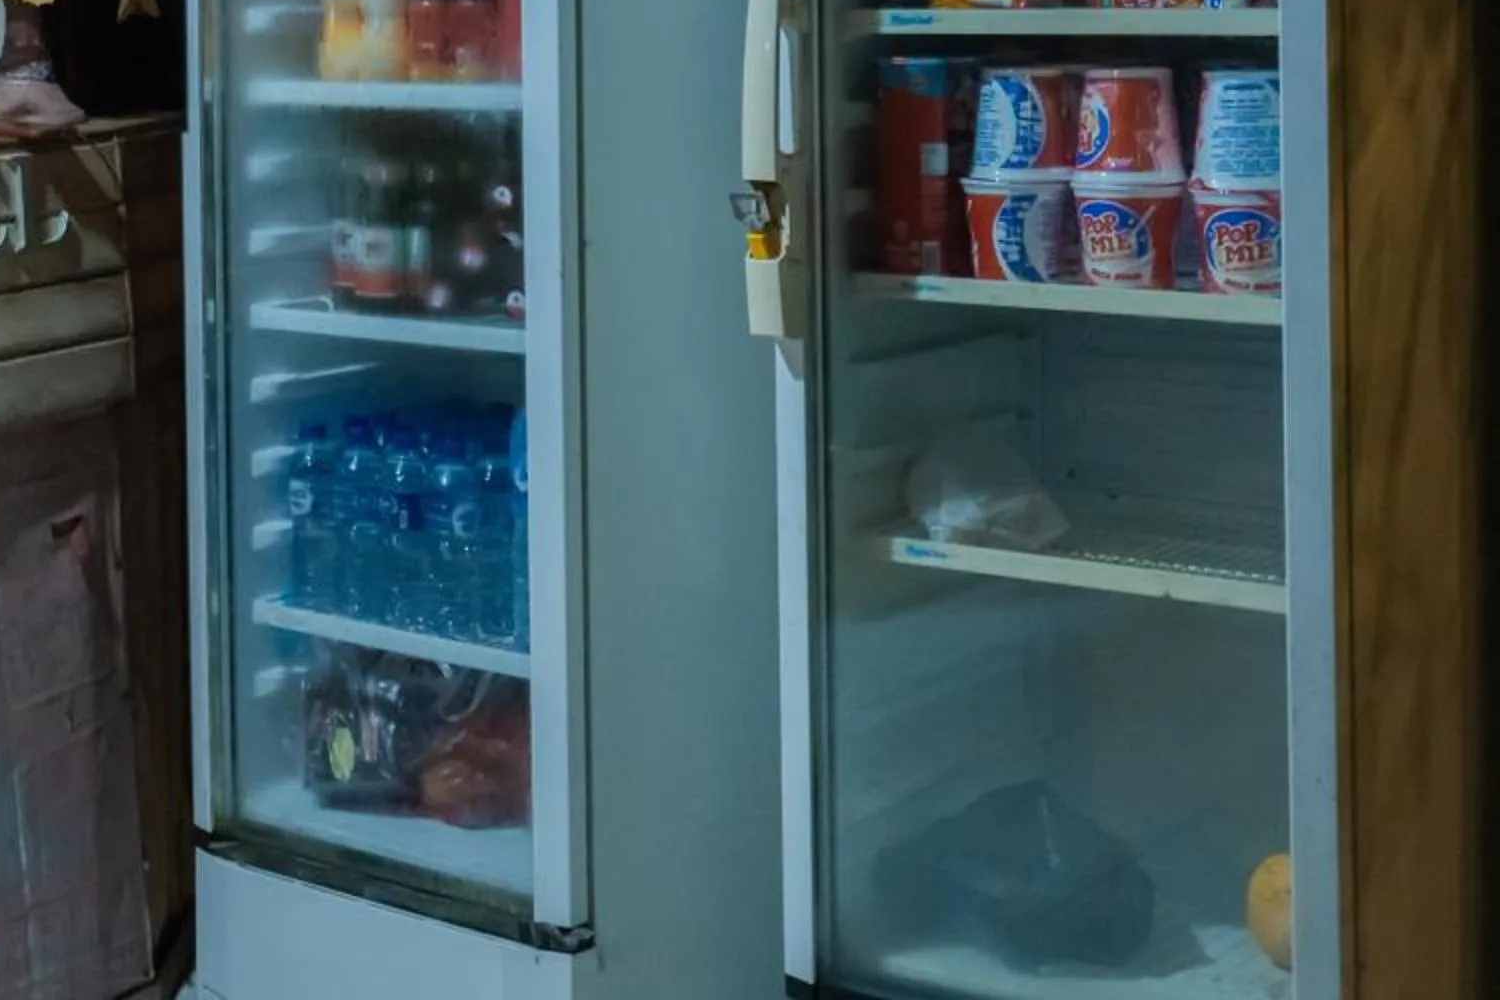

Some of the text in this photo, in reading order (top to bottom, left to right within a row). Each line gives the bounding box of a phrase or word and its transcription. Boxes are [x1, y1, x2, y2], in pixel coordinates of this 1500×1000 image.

[1083, 213, 1116, 235] POP
[1216, 222, 1257, 246] POP
[1225, 243, 1273, 263] MIE
